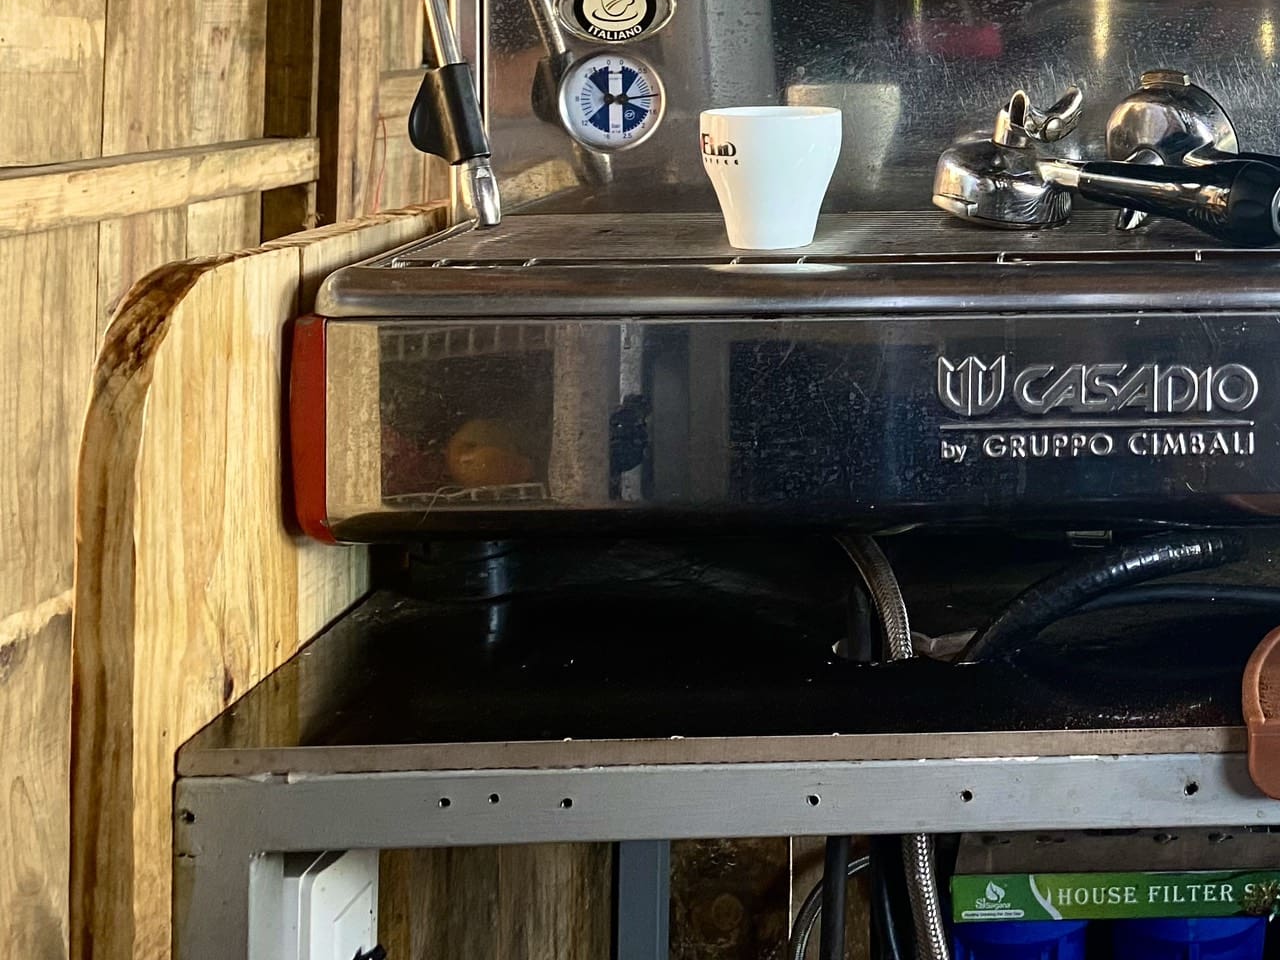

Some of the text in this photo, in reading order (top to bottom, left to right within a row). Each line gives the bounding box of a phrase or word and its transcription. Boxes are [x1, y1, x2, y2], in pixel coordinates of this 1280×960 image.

[588, 25, 642, 40] ITALIANO
[1013, 362, 1259, 414] CASADIO
[941, 431, 1255, 463] by GRUPPO CIMBALI
[1058, 886, 1138, 906] HOUSE
[1148, 883, 1235, 903] FILTER
